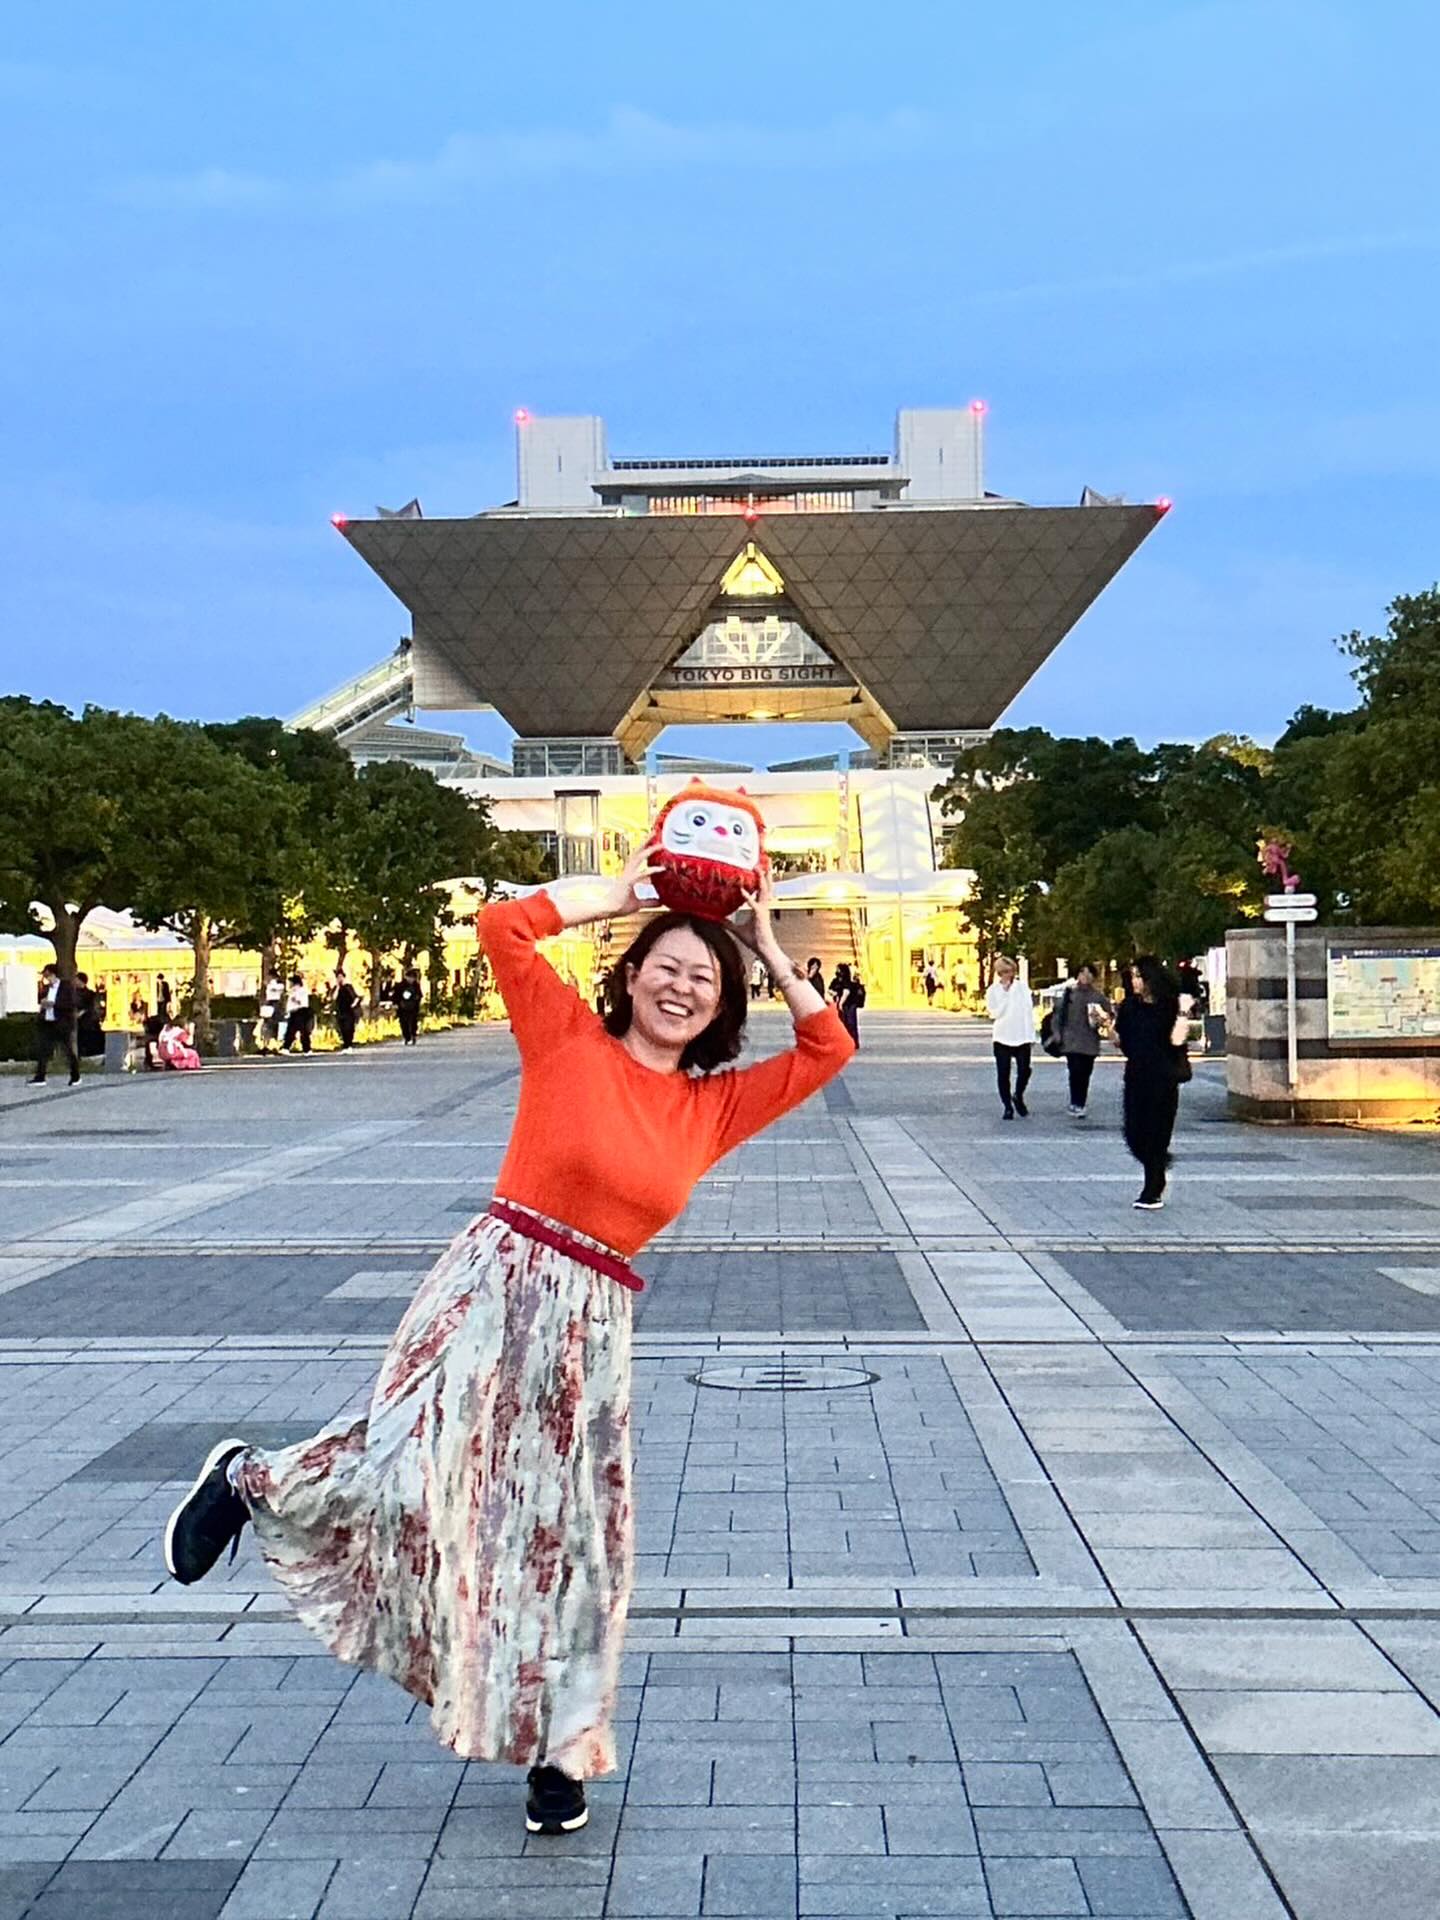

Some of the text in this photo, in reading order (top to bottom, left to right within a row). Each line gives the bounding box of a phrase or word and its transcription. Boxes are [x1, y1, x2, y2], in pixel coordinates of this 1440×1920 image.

[672, 667, 835, 682] TOKYO BIG SIGHT
